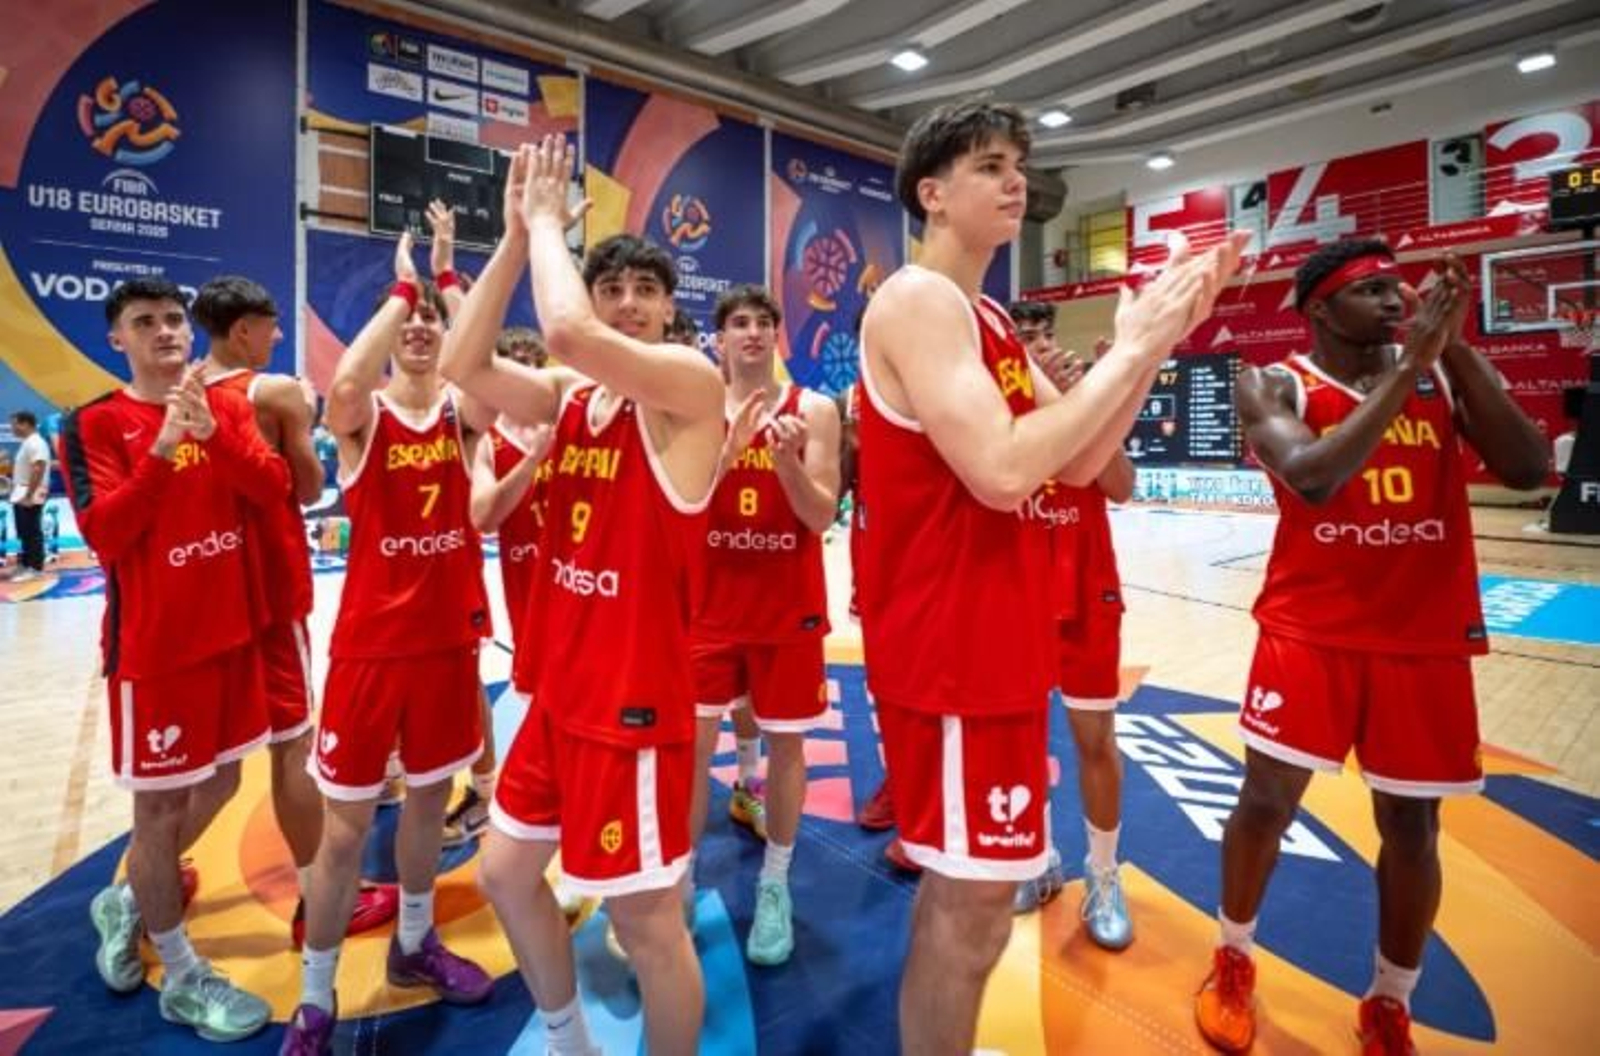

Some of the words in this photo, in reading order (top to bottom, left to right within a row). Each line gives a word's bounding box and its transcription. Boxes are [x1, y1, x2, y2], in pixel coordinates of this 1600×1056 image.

[1440, 139, 1471, 177] 3
[28, 184, 71, 210] U18
[78, 190, 222, 229] EUROBASKET
[1268, 160, 1357, 246] 4
[418, 483, 441, 519] 7
[739, 488, 758, 516] 8
[1362, 467, 1414, 504] 10
[571, 501, 592, 543] 9
[707, 529, 797, 550] endesa
